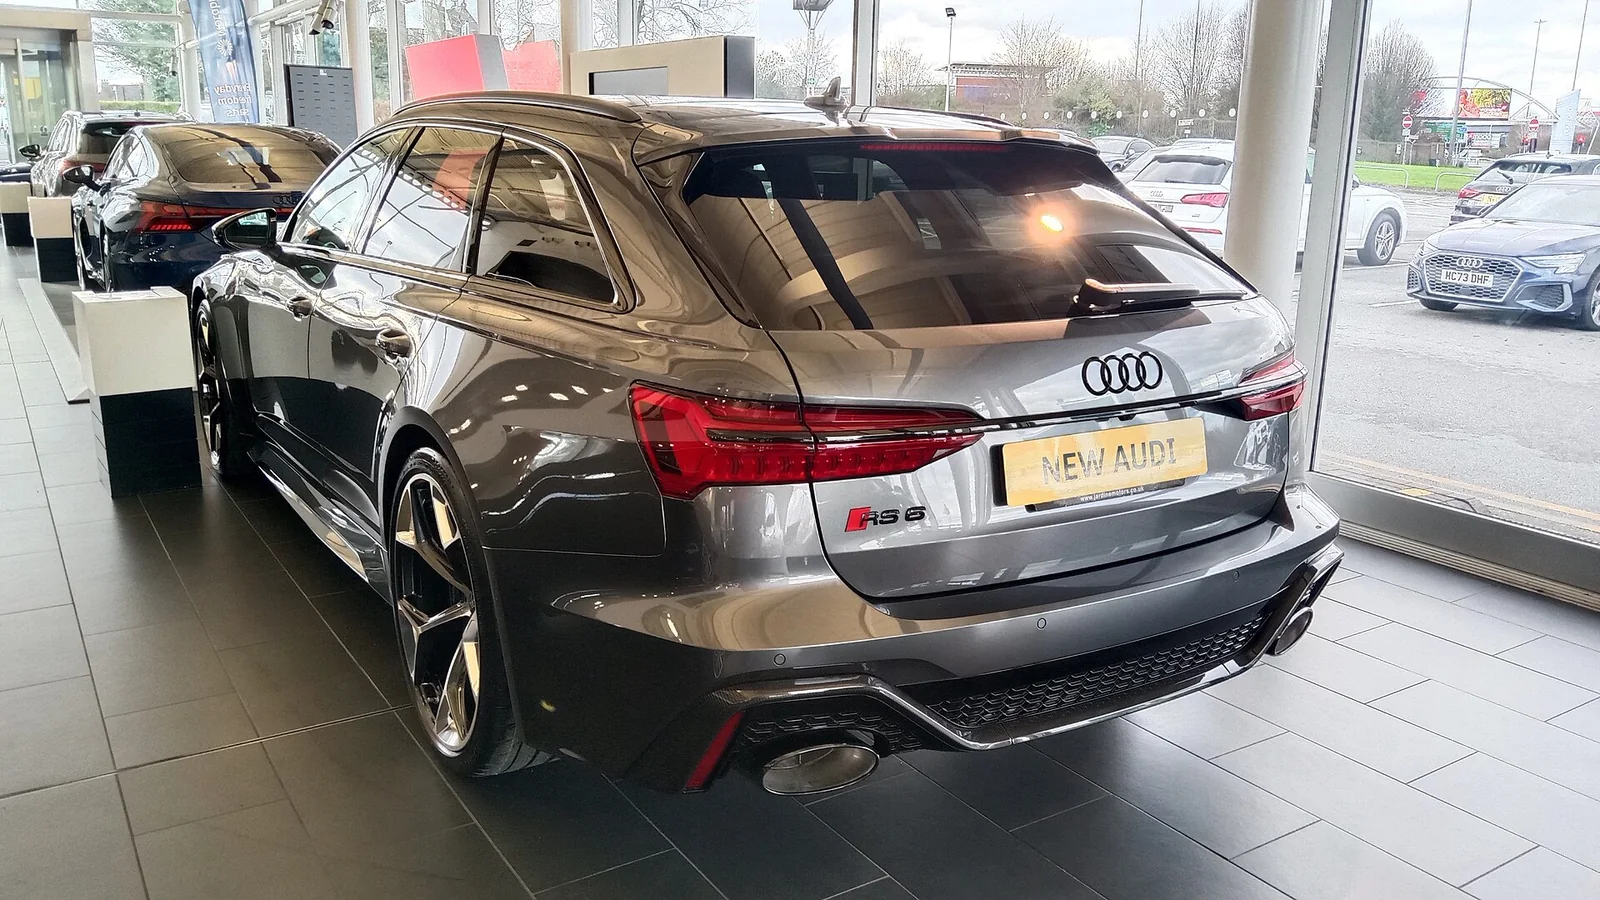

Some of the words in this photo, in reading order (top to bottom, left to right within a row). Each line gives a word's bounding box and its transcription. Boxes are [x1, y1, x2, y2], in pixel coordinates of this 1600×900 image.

[1445, 271, 1469, 282] HC73
[1470, 274, 1490, 284] DHF
[1042, 447, 1105, 484] NEW
[1113, 438, 1177, 473] AUDI
[1080, 485, 1144, 502] www.jardinemotors.co.uk
[857, 508, 899, 528] RS
[904, 506, 926, 521] 6
